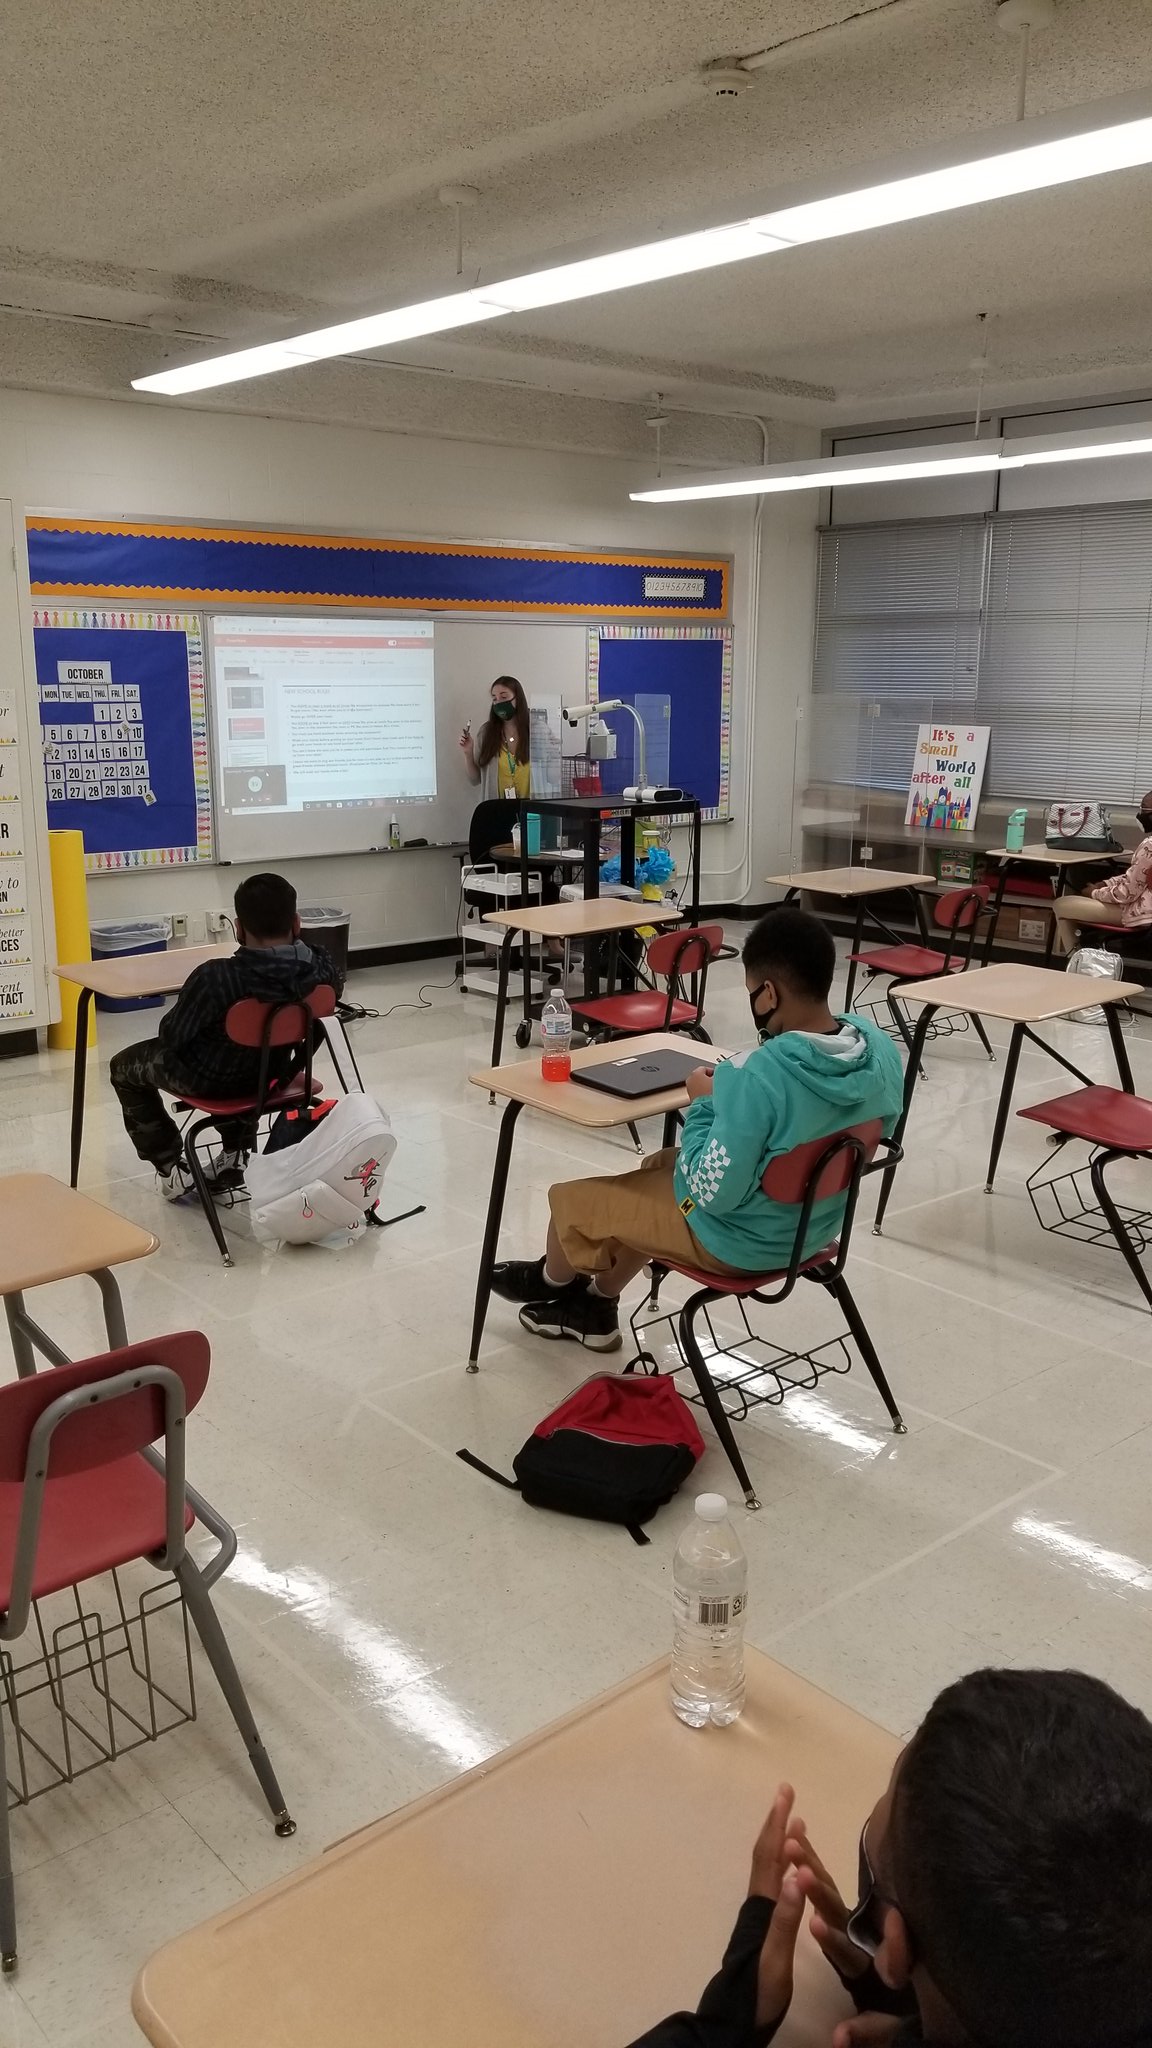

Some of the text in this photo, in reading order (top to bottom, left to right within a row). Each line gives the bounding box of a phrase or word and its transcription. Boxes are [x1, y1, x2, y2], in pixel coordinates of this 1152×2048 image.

[67, 668, 104, 680] OCTOBER
[44, 690, 59, 699] MON.
[61, 690, 74, 699] TUE.
[76, 690, 91, 699] WED.
[94, 689, 106, 698] THU.
[111, 689, 122, 698] FRI.
[126, 689, 138, 698] SAT.
[100, 708, 137, 720] 1 2 3
[51, 727, 142, 740] 5 6 7 8 9 10
[932, 729, 975, 742] It's a
[67, 749, 77, 760] 13
[84, 749, 94, 759] 14
[101, 748, 111, 758] 15
[118, 747, 128, 757] 16
[134, 746, 143, 757] 17
[920, 742, 959, 757] Small
[51, 765, 146, 780] 18 20 21 22 23 24
[935, 759, 976, 775] World
[912, 771, 972, 789] after all
[51, 784, 147, 799] 26 27 28 29 30 31
